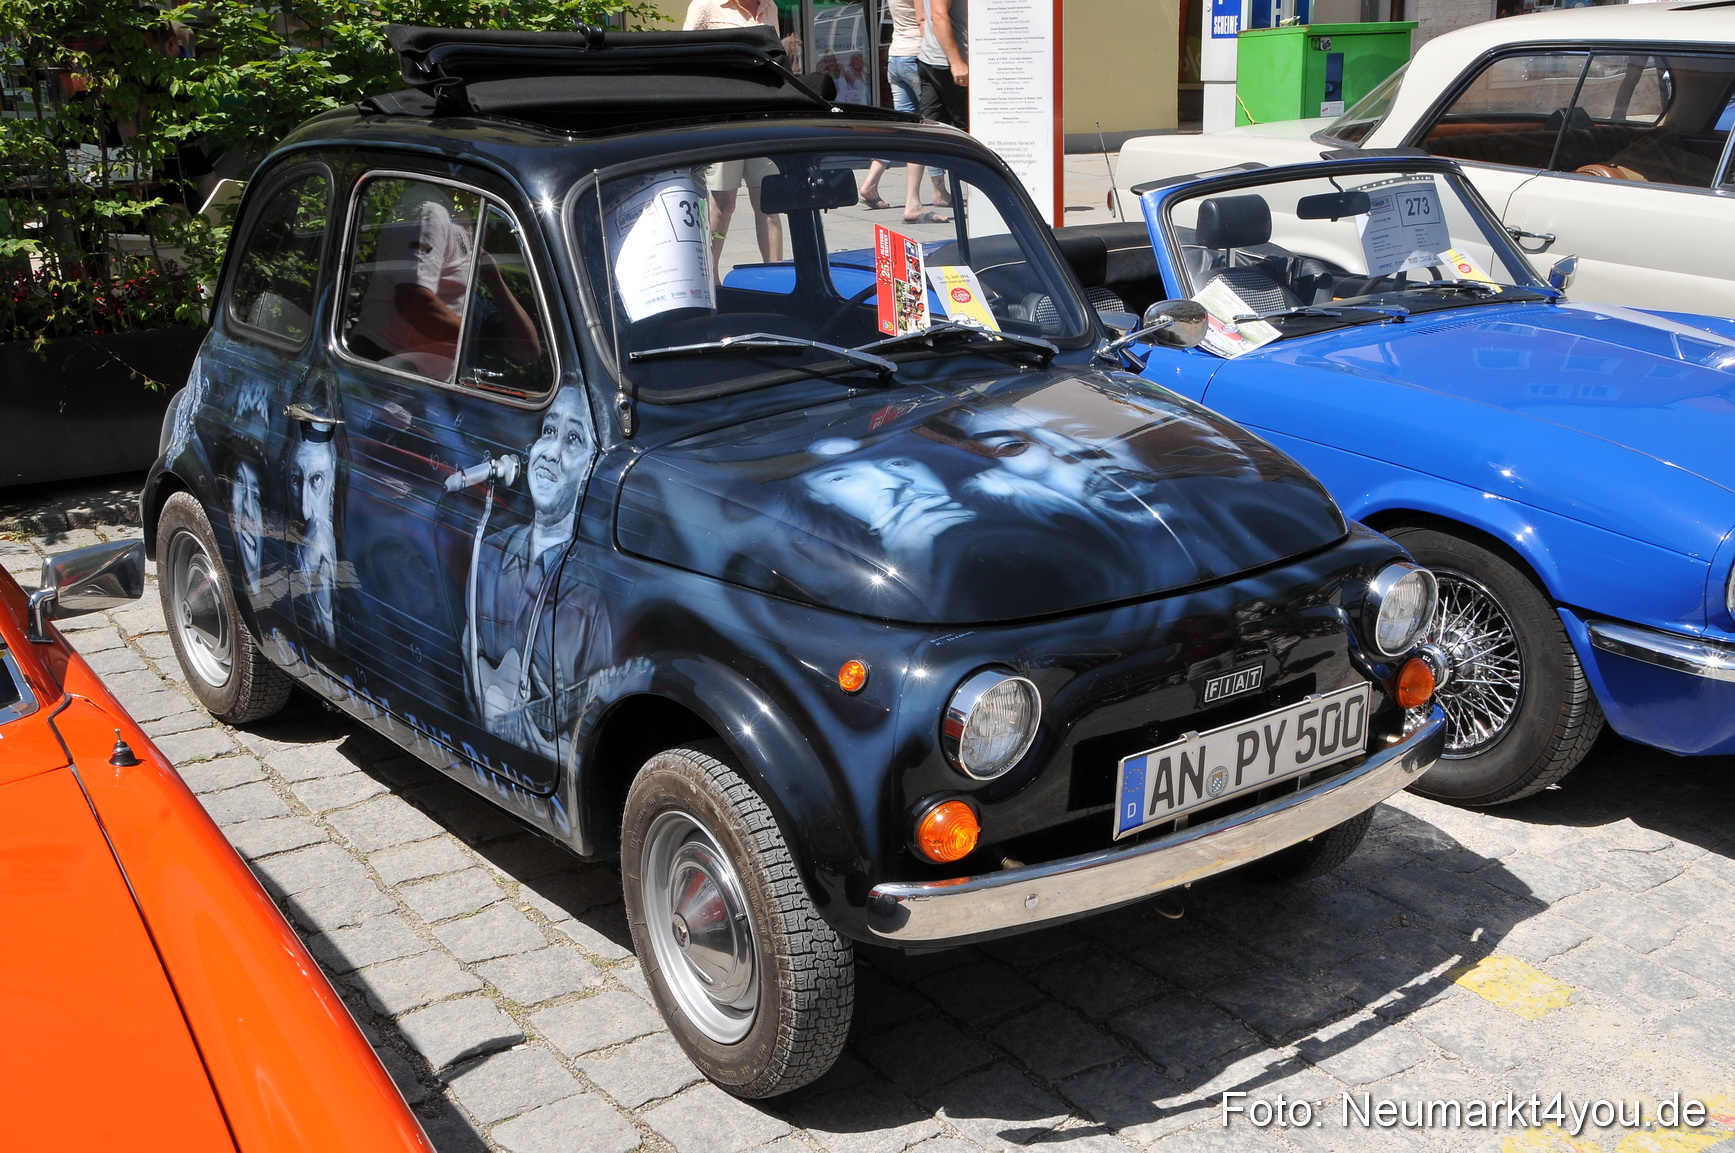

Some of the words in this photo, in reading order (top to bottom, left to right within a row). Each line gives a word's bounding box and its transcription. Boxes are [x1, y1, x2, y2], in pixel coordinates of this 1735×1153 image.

[1213, 15, 1239, 35] SCHEINE
[1405, 196, 1430, 216] 273
[1208, 669, 1261, 697] FIAT
[1149, 746, 1206, 816] AN
[1235, 719, 1287, 787] PY
[1295, 694, 1365, 764] 500
[1126, 802, 1137, 819] D
